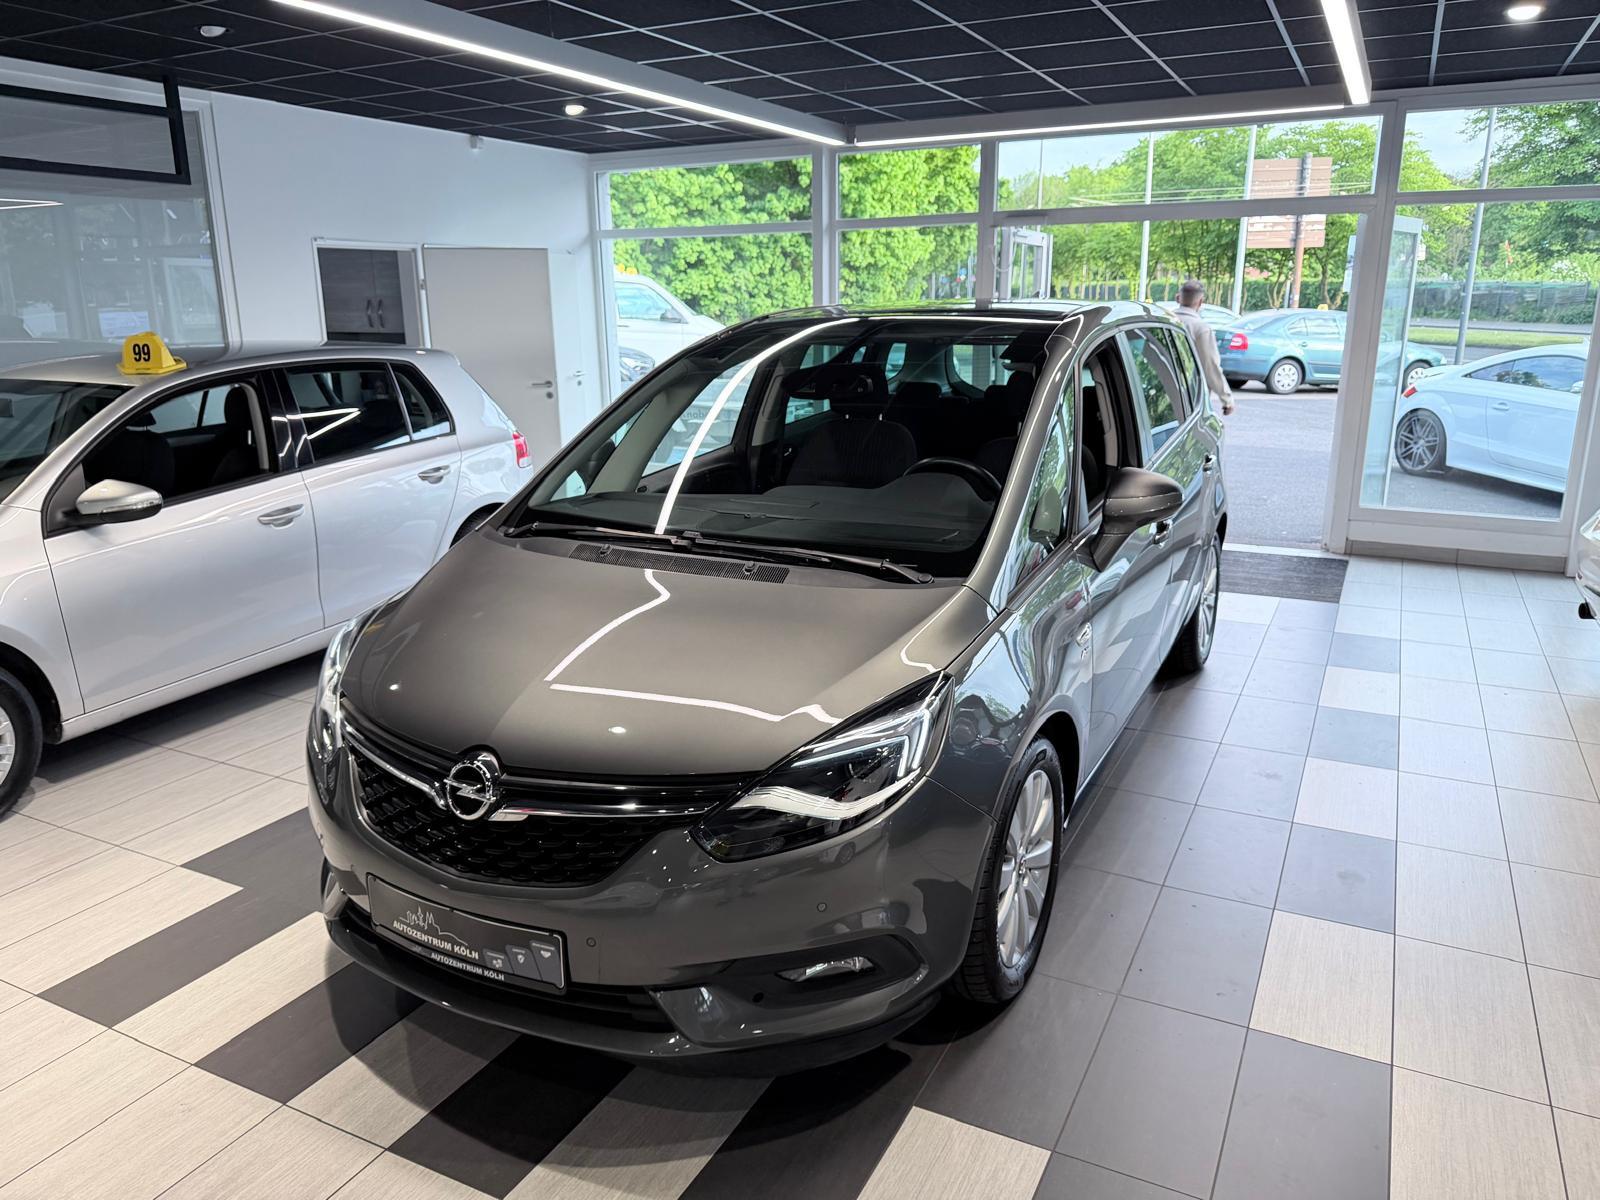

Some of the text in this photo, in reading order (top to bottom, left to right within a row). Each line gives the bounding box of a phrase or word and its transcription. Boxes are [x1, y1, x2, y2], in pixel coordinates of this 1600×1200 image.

[132, 343, 151, 362] 99
[393, 920, 479, 960] AUTOZENTRUM KÖLN
[430, 952, 483, 976] AUTOZENTRUM
[484, 967, 505, 981] KÖLN
